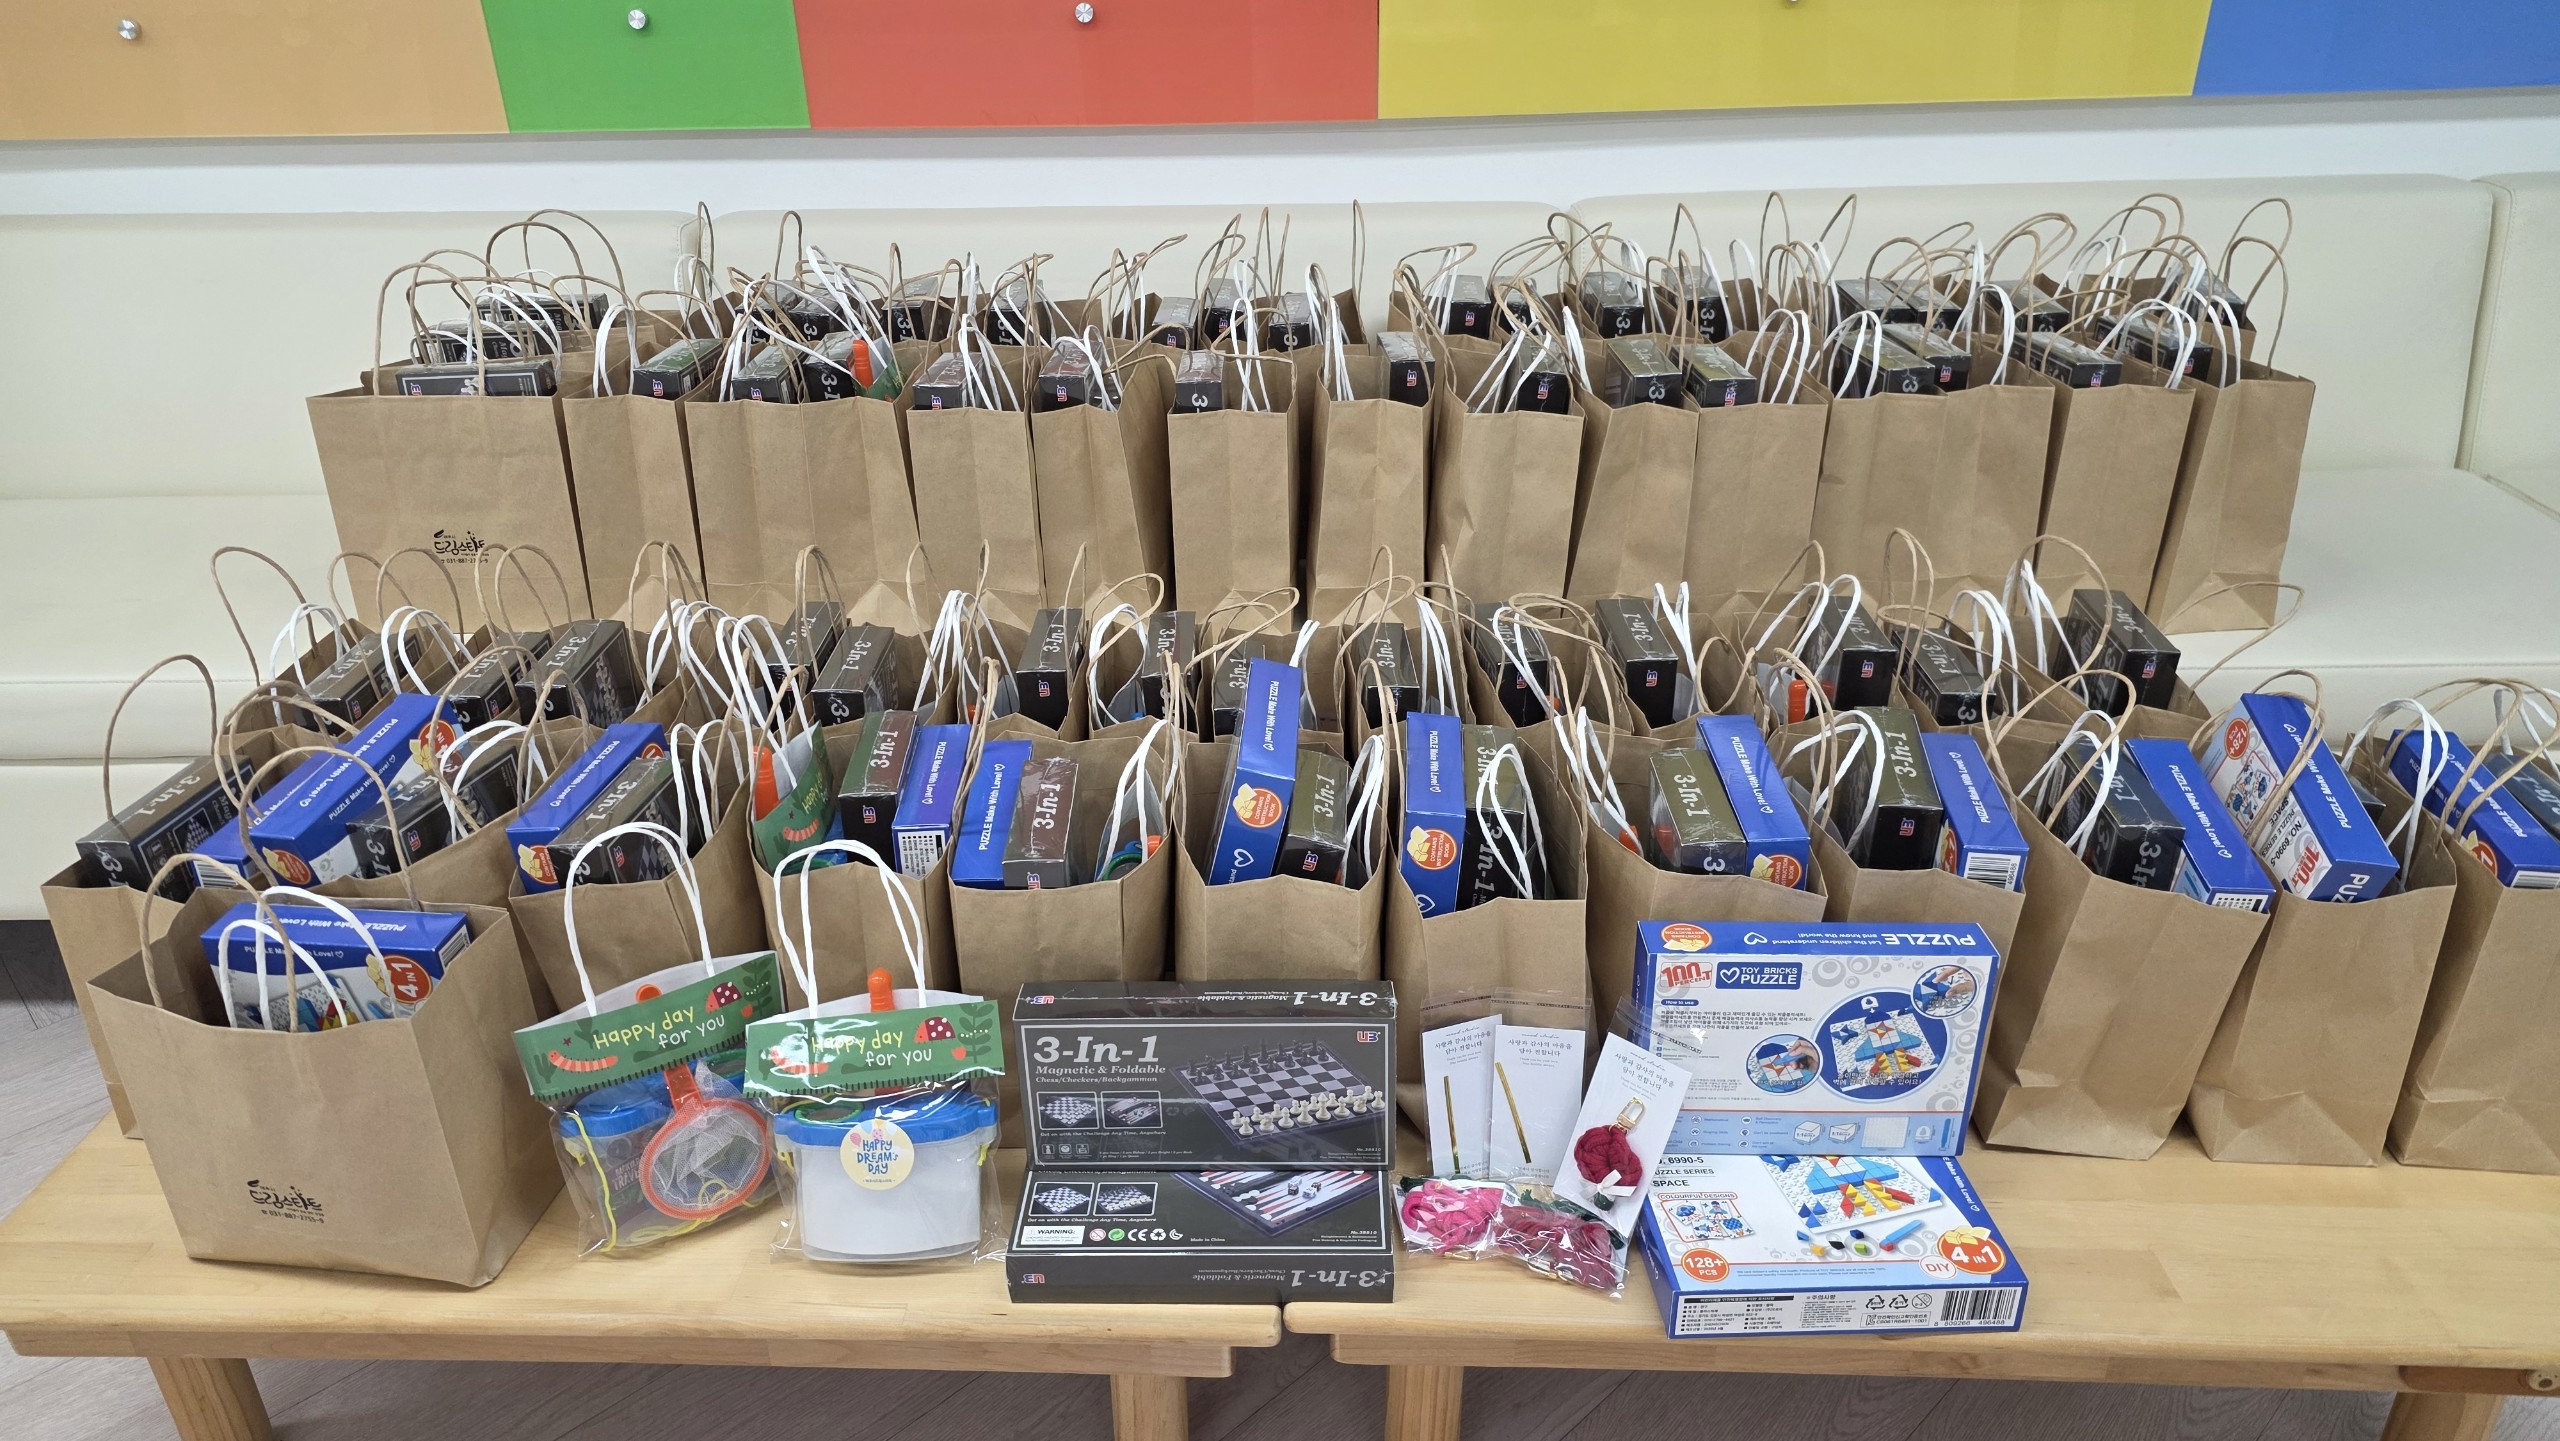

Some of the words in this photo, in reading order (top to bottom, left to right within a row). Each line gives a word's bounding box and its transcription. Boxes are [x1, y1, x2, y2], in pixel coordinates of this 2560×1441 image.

[1043, 624, 1064, 652] 3-In-1
[1623, 614, 1653, 641] 3-In-1
[546, 636, 586, 666] 3-In-1
[842, 641, 871, 670] 3-In-1
[1376, 639, 1396, 668] 3-In-1
[1921, 643, 1960, 674] 3-In-1
[1269, 680, 1279, 701] PUZZLE
[366, 718, 399, 745] PUZZLE
[1430, 731, 1438, 749] PUZZLE
[2230, 729, 2247, 754] 128+
[870, 731, 898, 768] 3-In-1
[1886, 732, 1916, 778] 3-In-1
[991, 772, 1002, 789] Love!
[1731, 737, 1746, 762] PUZZLE
[1740, 758, 1753, 776] Make
[1754, 788, 1768, 806] Love!
[135, 775, 201, 815] 3-In-1
[586, 781, 637, 820] 3-In-1
[988, 788, 999, 805] With
[1034, 784, 1061, 829] 3-In-1
[1314, 774, 1335, 818] 3-In-1
[1674, 775, 1709, 817] 3-In-1
[2168, 764, 2191, 796] PUZZLE
[2184, 792, 2200, 811] Make
[2196, 810, 2210, 827] With
[2206, 825, 2225, 849] Love!
[328, 798, 351, 820] PUZZLE
[985, 804, 995, 823] Make
[1255, 796, 1264, 820] CONTAINS
[1261, 794, 1271, 825] INSTRUCTION
[1972, 801, 1990, 823] PUZZLE
[2269, 798, 2289, 825] SPACE
[2326, 797, 2352, 828] PUZZLE
[2278, 809, 2295, 834] PUZZLE
[2290, 821, 2302, 838] NO.
[2498, 809, 2527, 837] PUZZLE
[979, 823, 992, 850] PUZZLE
[2261, 834, 2278, 858] SERIES
[1430, 838, 1438, 862] CONTAINS
[2270, 840, 2290, 867] 6990-5
[1881, 934, 1976, 946] PUZZLE
[391, 963, 413, 971] 1
[407, 972, 417, 981] IN
[398, 985, 417, 997] 4
[1741, 975, 1797, 985] PUZZLE
[1294, 992, 1377, 1006] 3-In-1
[593, 1022, 655, 1049] Happy
[662, 1006, 694, 1030] day
[658, 1029, 691, 1048] for
[696, 1015, 725, 1037] you
[812, 1036, 865, 1055] Happy
[872, 1029, 902, 1049] day
[1033, 1035, 1158, 1063] 3-In-1
[1434, 1039, 1453, 1048] 사랑과
[1460, 1041, 1482, 1051] 전합니다
[866, 1051, 896, 1066] for
[902, 1048, 932, 1065] you
[1616, 1053, 1633, 1066] 사랑과
[1636, 1063, 1654, 1077] 감사의
[1035, 1065, 1094, 1075] Magnetic
[1111, 1065, 1165, 1074] Foldable
[1637, 1074, 1661, 1091] 전합니다
[863, 1139, 892, 1152] HAPPY
[868, 1163, 888, 1174] DAY
[1945, 1162, 1956, 1176] Make
[1954, 1176, 1964, 1188] With
[1961, 1189, 1975, 1204] Love!
[1686, 1257, 1723, 1268] 128+
[1951, 1246, 1969, 1263] 4
[1973, 1255, 1986, 1264] IN
[1982, 1245, 1998, 1263] 1
[1291, 1270, 1379, 1287] 3-In-1
[1926, 1263, 1950, 1272] DIY
